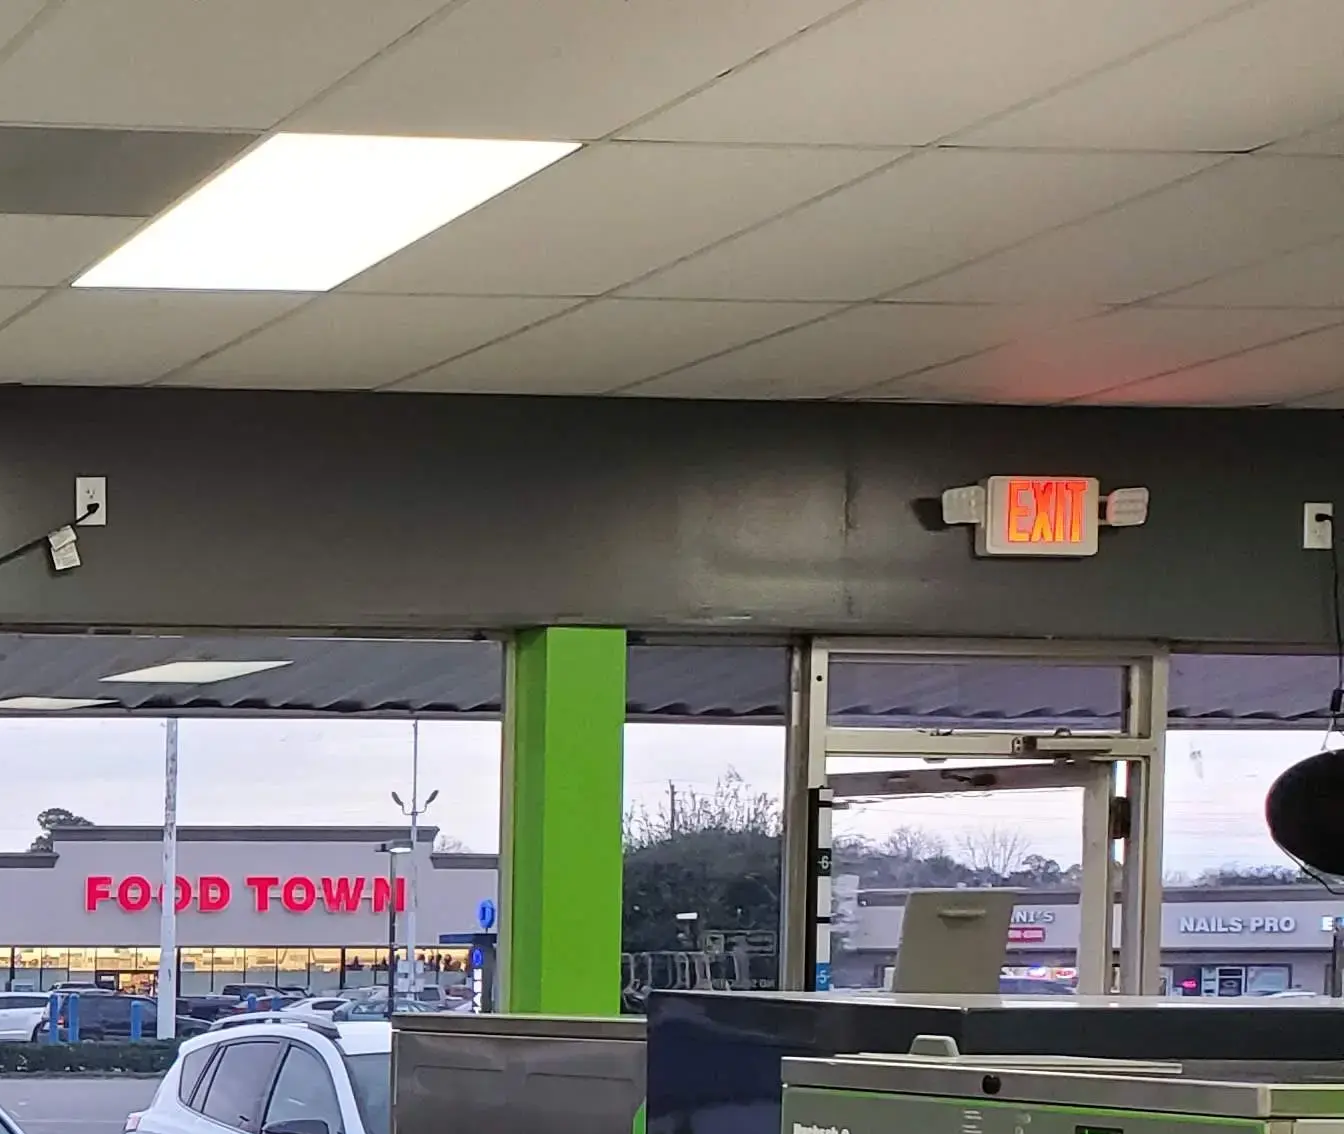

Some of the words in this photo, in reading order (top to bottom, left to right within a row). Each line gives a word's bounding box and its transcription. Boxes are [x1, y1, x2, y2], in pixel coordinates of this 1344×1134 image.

[1007, 480, 1088, 543] EXIT
[85, 875, 232, 913] FOOD
[246, 875, 408, 913] TOWN
[1013, 910, 1055, 924] NI'S
[1179, 916, 1244, 932] NAILS
[1249, 916, 1297, 932] PRO
